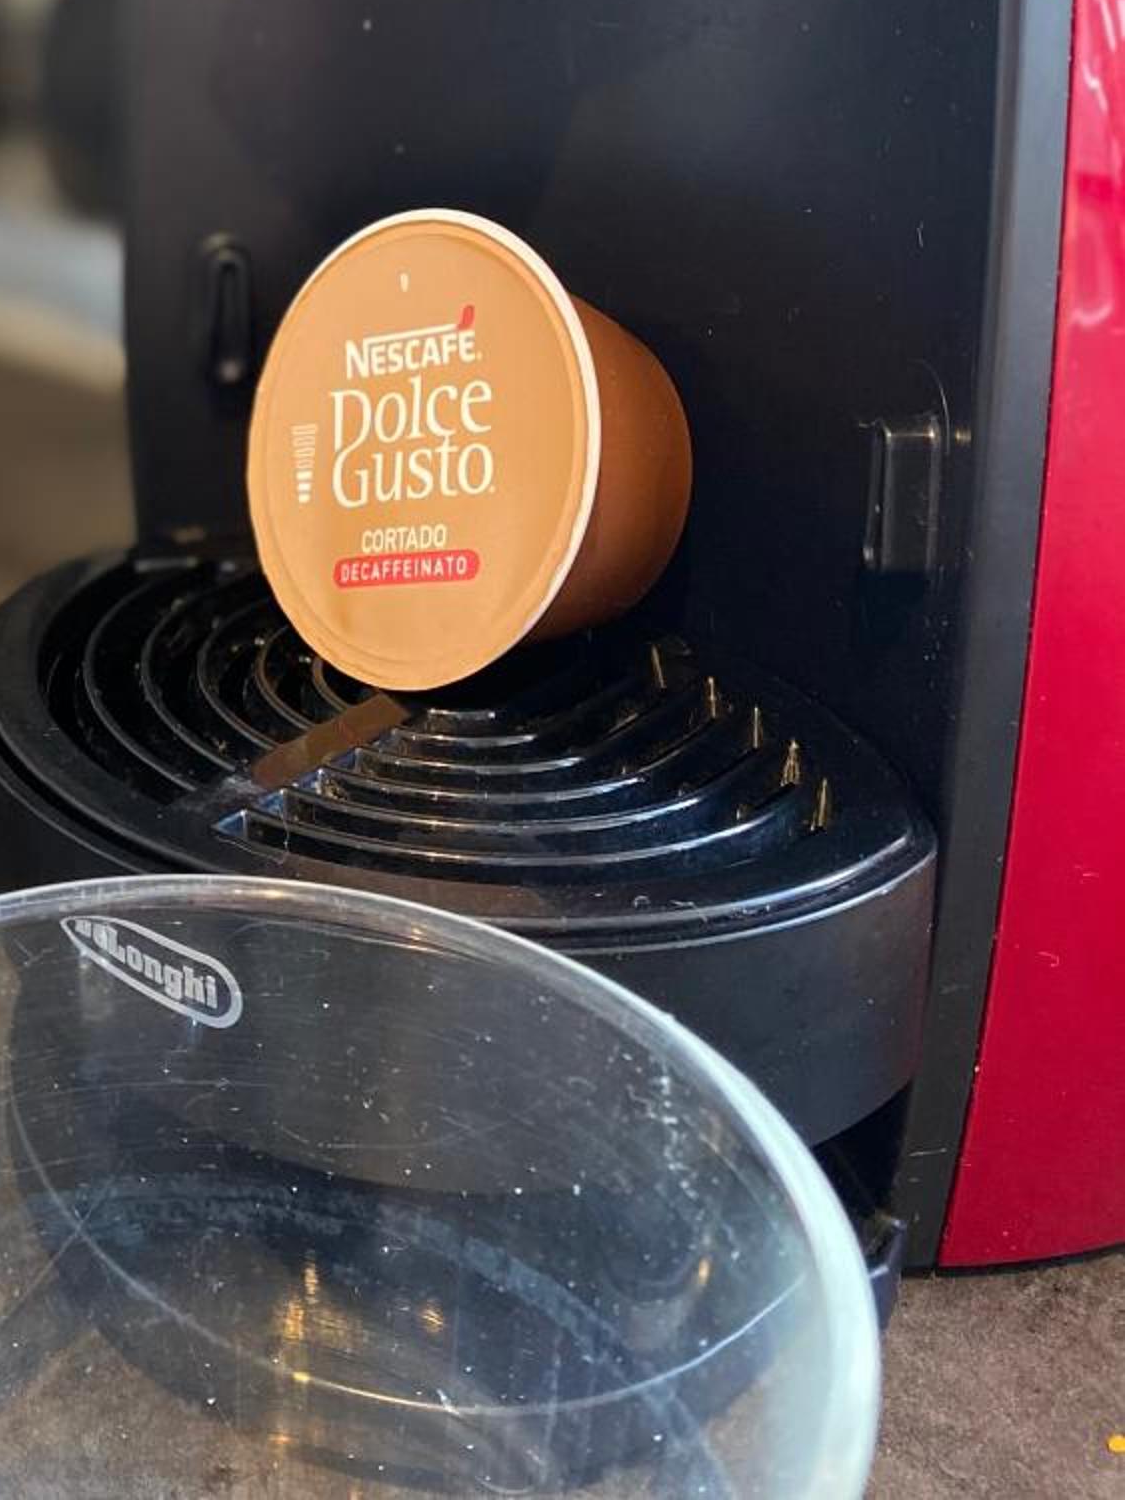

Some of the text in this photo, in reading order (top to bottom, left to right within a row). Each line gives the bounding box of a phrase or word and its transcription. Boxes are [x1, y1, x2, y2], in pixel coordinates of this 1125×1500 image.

[330, 376, 493, 449] Dolce
[332, 432, 494, 508] Gusto
[361, 523, 447, 552] CORTADO
[340, 557, 469, 583] DECAFFEINATO
